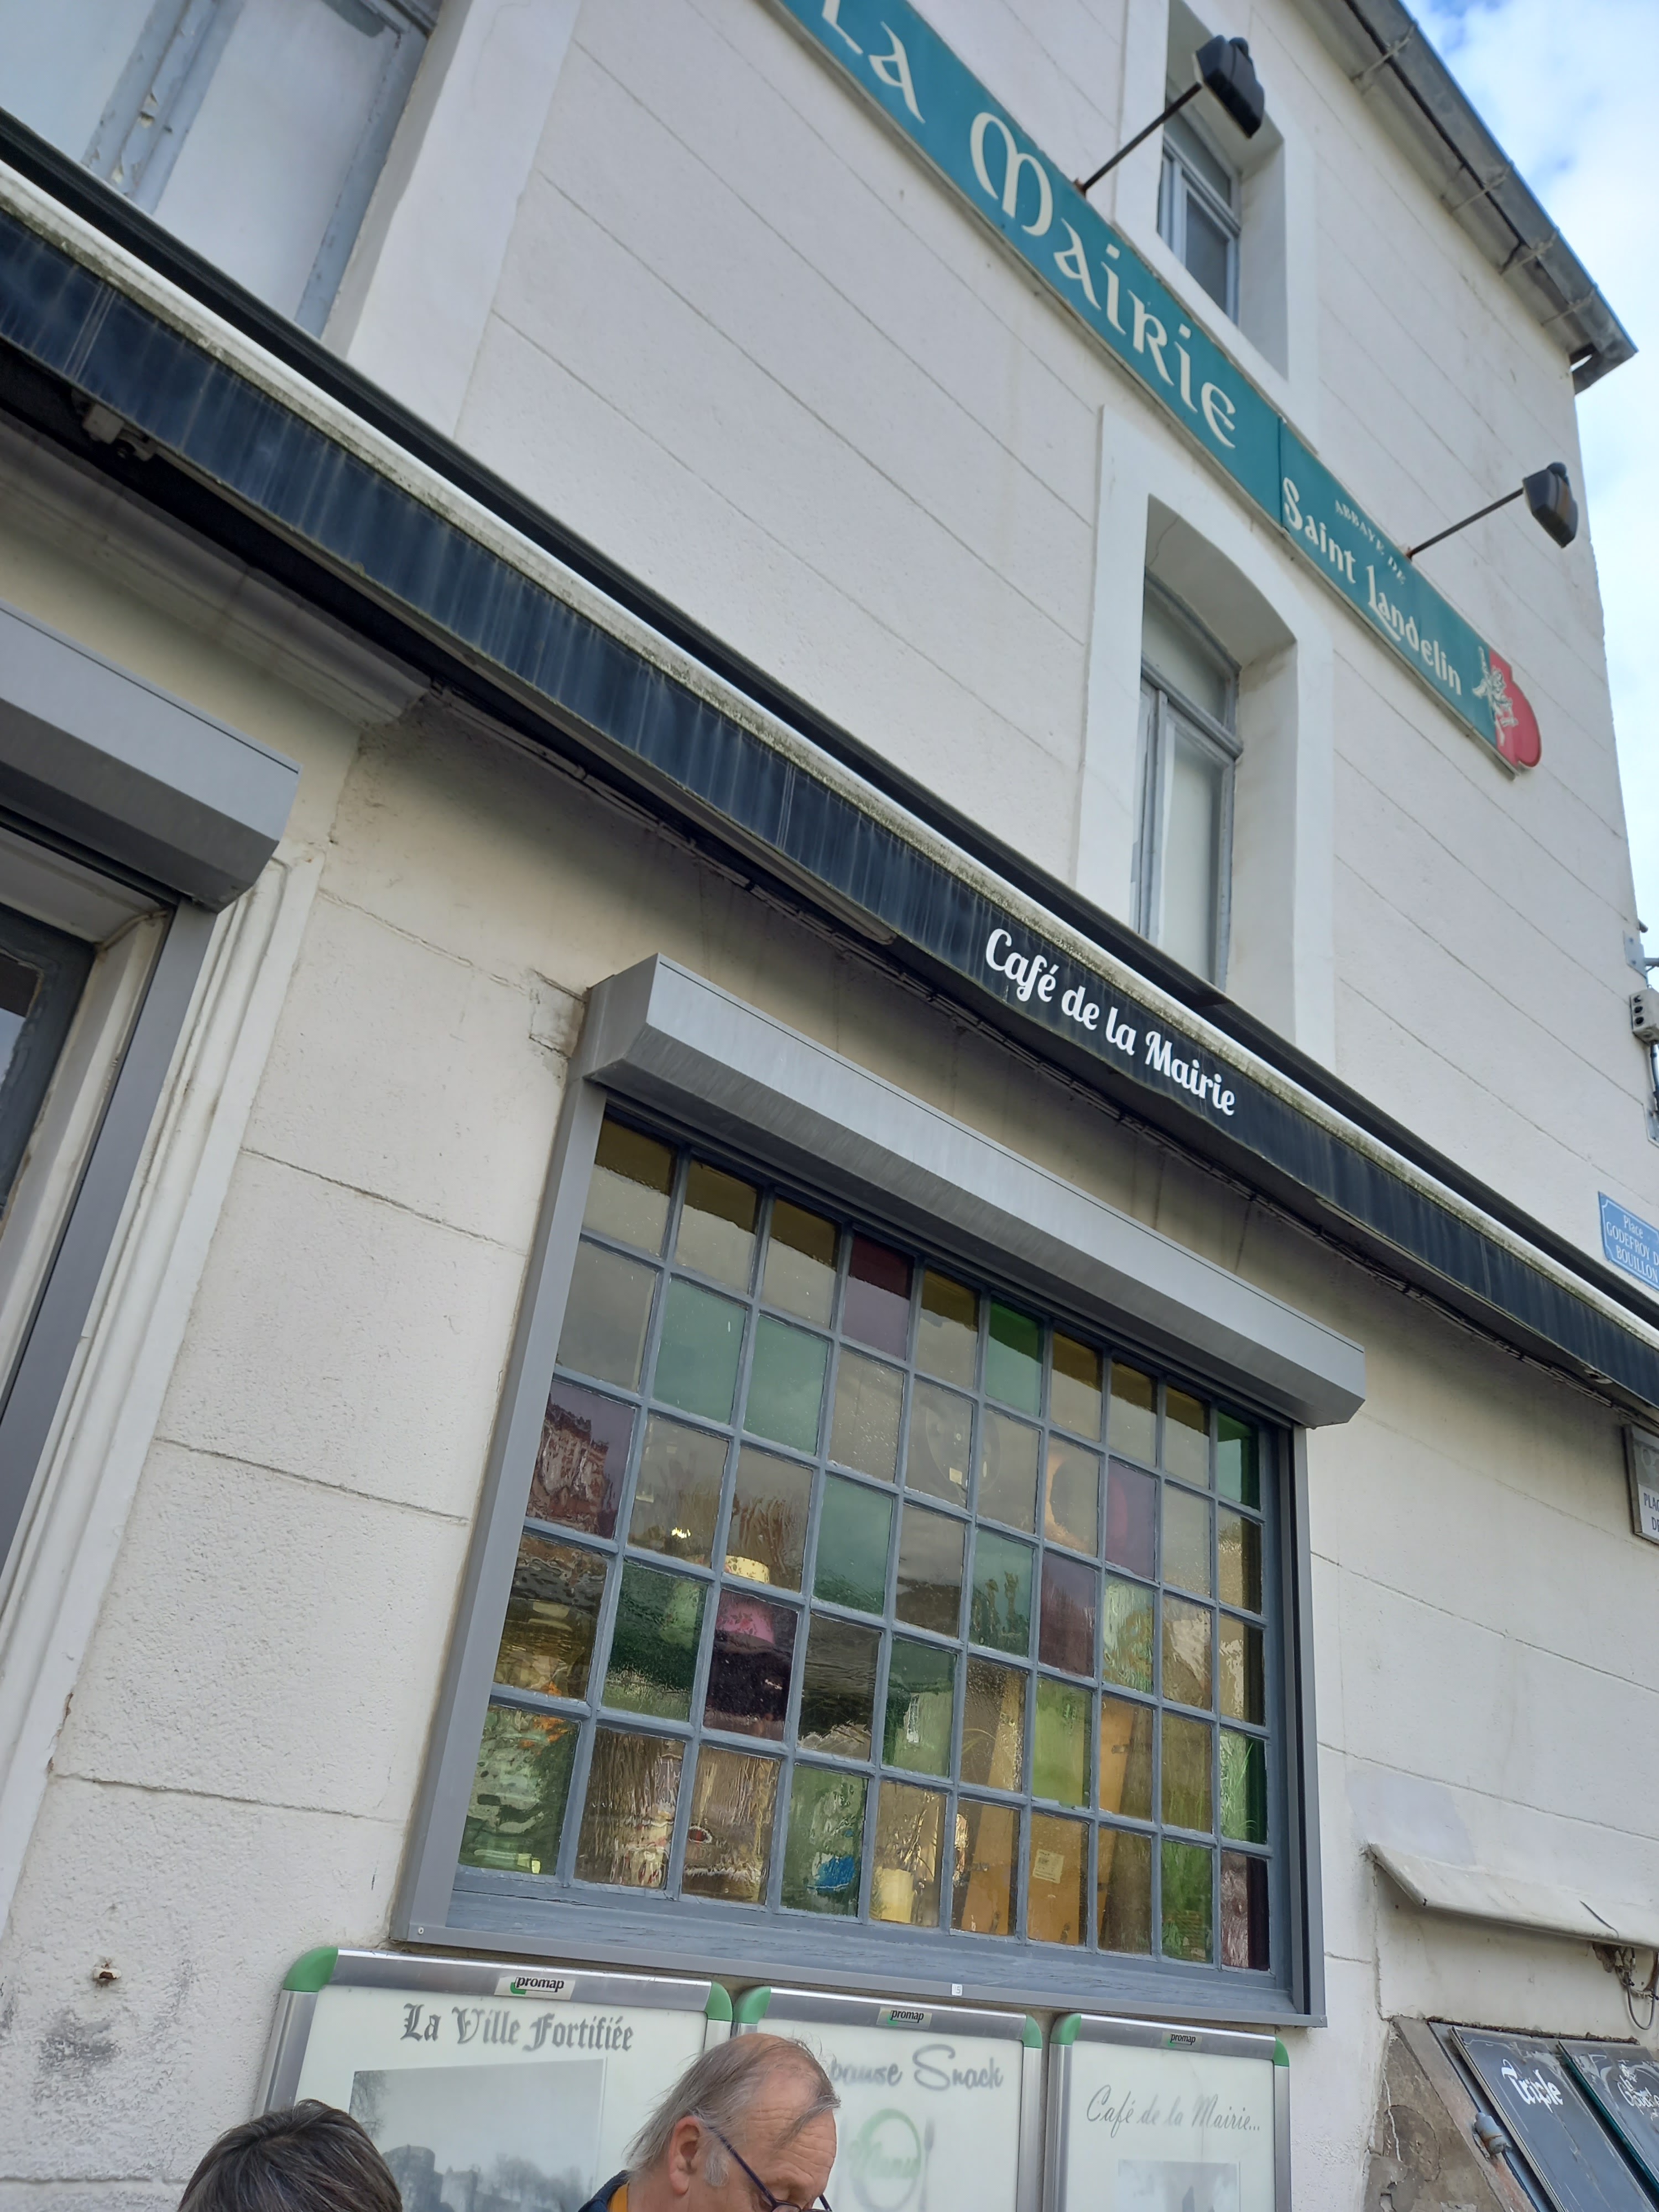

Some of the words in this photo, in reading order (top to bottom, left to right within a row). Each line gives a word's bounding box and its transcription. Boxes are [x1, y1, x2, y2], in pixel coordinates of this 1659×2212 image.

[1335, 499, 1385, 556] ABBAYE
[1282, 477, 1357, 584] Saint
[1366, 564, 1462, 696] Landelin
[985, 928, 1060, 1003] Café
[1061, 985, 1100, 1030] de
[1105, 1006, 1137, 1056] la
[1145, 1030, 1236, 1116] Mairie
[1606, 1221, 1650, 1261] GODEFROY
[1624, 1214, 1644, 1239] Place
[1616, 1244, 1658, 1284] BOUILLON
[516, 1976, 565, 1993] promap
[400, 2002, 442, 2042] La
[451, 2006, 521, 2045] Ville
[522, 2012, 634, 2052] Fortifiée
[890, 2009, 925, 2023] promap
[1170, 2033, 1196, 2046] promap
[912, 2043, 1004, 2092] Snack
[1087, 2084, 1136, 2138] Café
[1137, 2093, 1160, 2126] de
[1163, 2094, 1184, 2127] la
